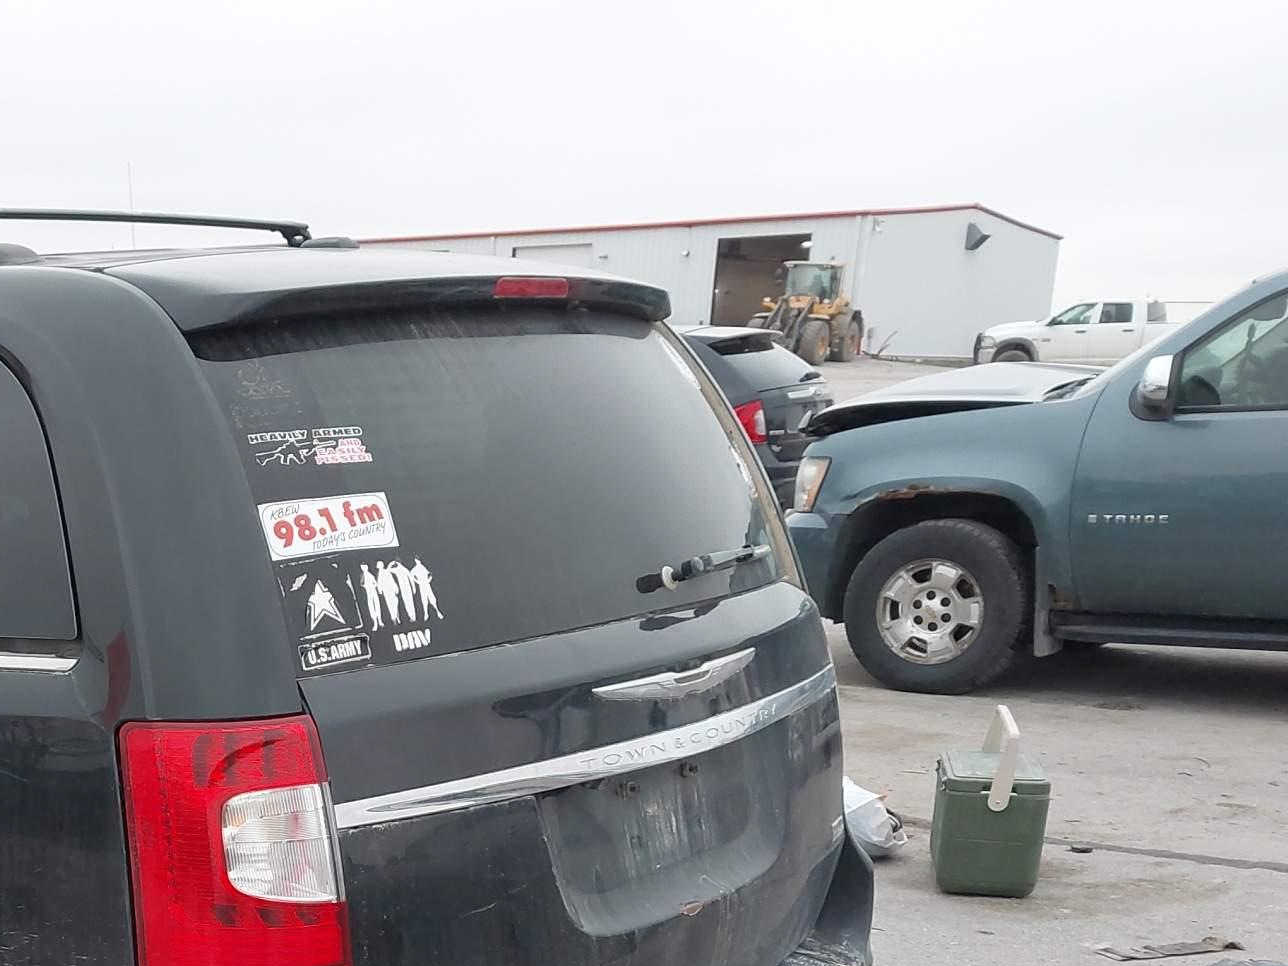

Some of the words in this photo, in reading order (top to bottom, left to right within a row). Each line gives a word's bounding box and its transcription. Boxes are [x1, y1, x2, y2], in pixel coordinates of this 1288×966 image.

[248, 430, 308, 444] HEAVILY
[313, 427, 363, 438] ARMED
[339, 439, 362, 447] AND
[317, 446, 366, 456] EASILY
[271, 504, 300, 520] KBEW
[1103, 514, 1169, 524] TAHOE
[273, 507, 338, 548] 98.1
[343, 501, 384, 527] fm
[313, 532, 346, 551] TODAY'S
[348, 522, 386, 539] COUNTRY
[580, 742, 666, 769] TOWN
[675, 737, 686, 750] &
